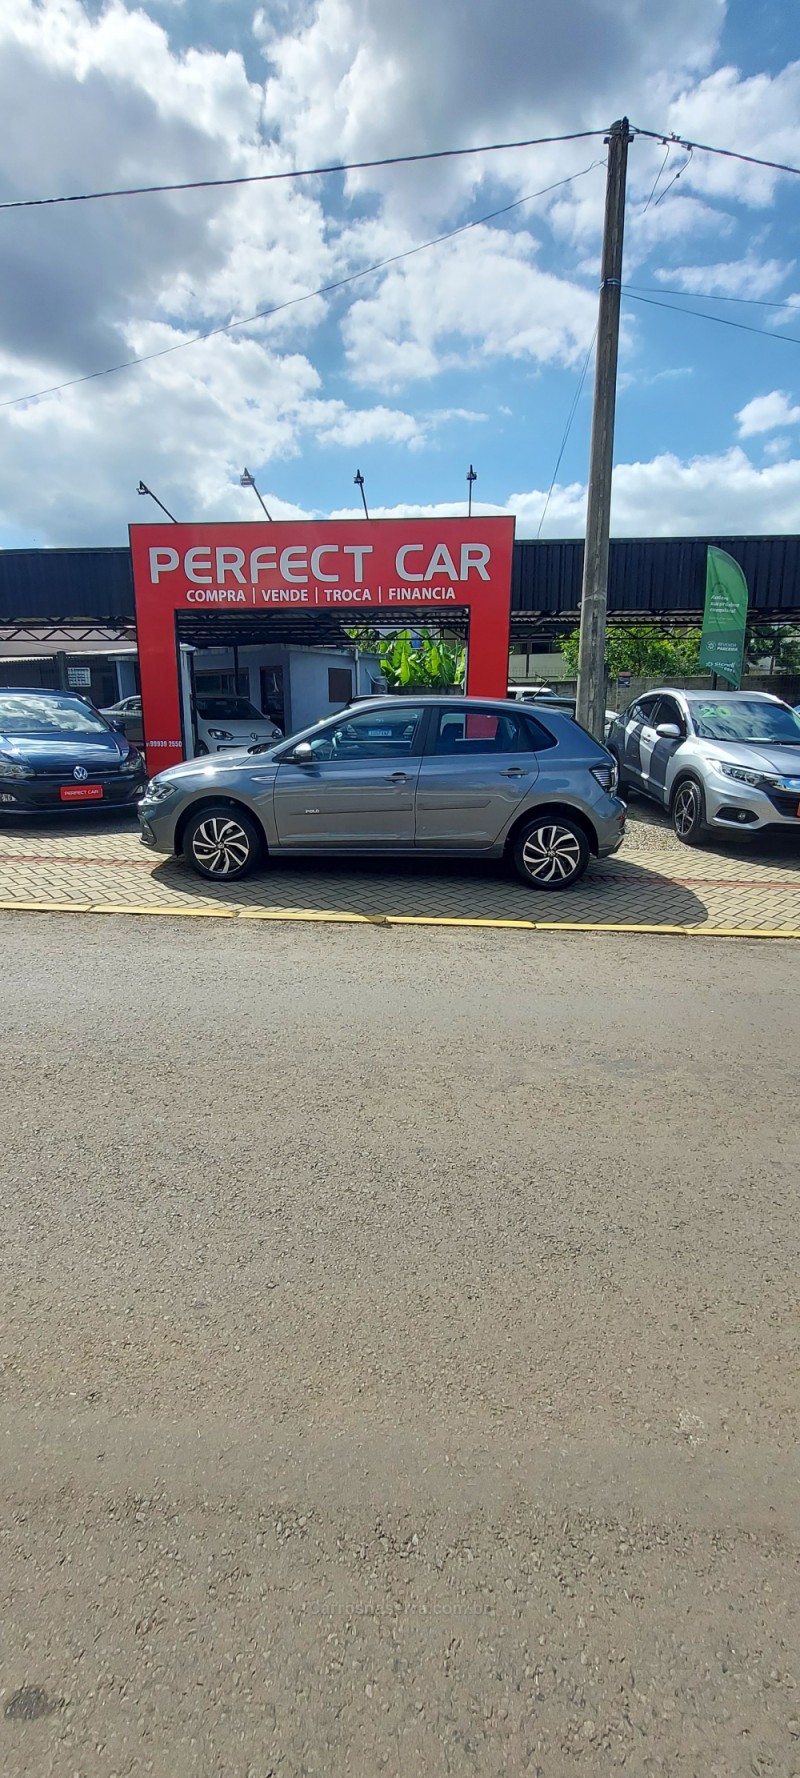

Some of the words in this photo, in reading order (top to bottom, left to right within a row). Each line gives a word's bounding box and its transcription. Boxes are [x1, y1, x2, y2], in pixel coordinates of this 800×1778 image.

[149, 545, 373, 584] PERFECT
[395, 543, 491, 582] CAR
[186, 589, 246, 602] COMPRA
[261, 589, 308, 602] VENDE
[324, 588, 372, 602] TROCA
[388, 587, 456, 600] FINANCIA
